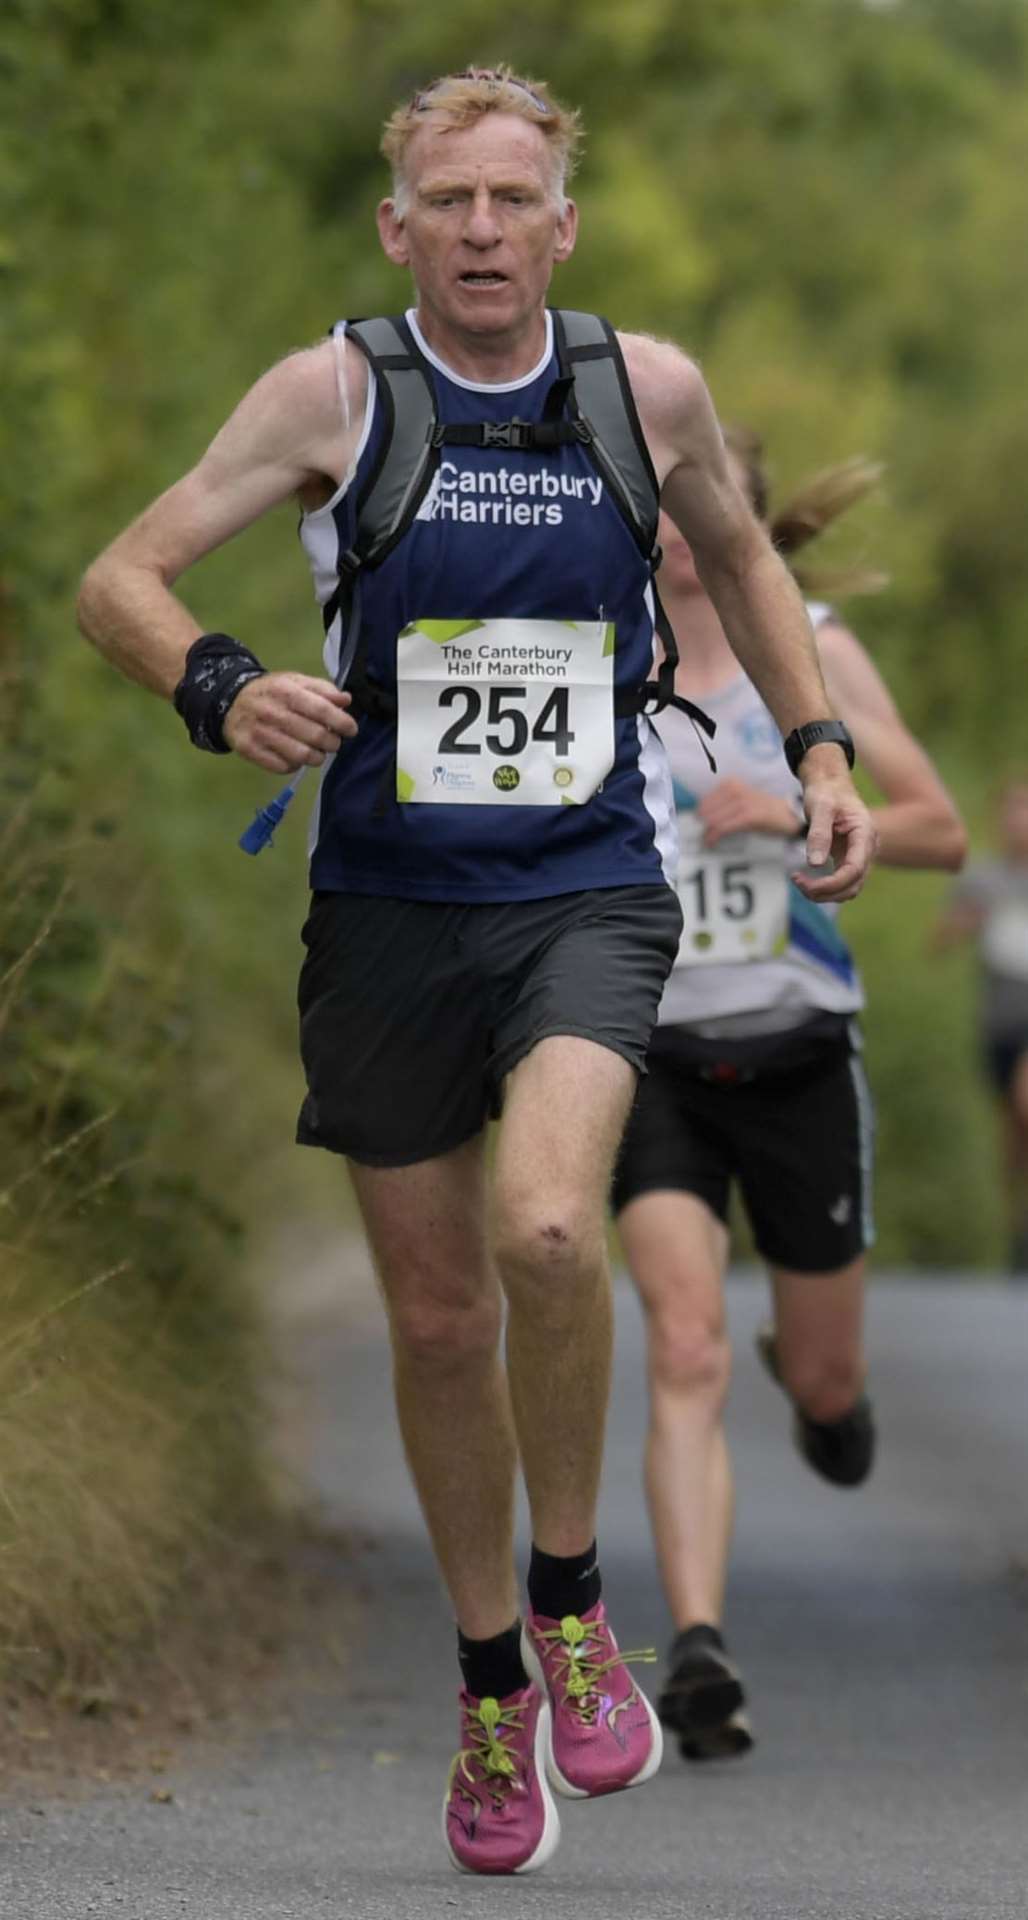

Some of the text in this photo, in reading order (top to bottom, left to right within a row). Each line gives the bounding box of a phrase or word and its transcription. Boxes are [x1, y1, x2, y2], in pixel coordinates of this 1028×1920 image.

[440, 461, 603, 506] Canterbury
[440, 492, 563, 526] Harriers
[441, 645, 573, 663] The Canterbury
[447, 662, 567, 677] Half Marathon
[437, 685, 576, 757] 254
[674, 864, 755, 921] 15
